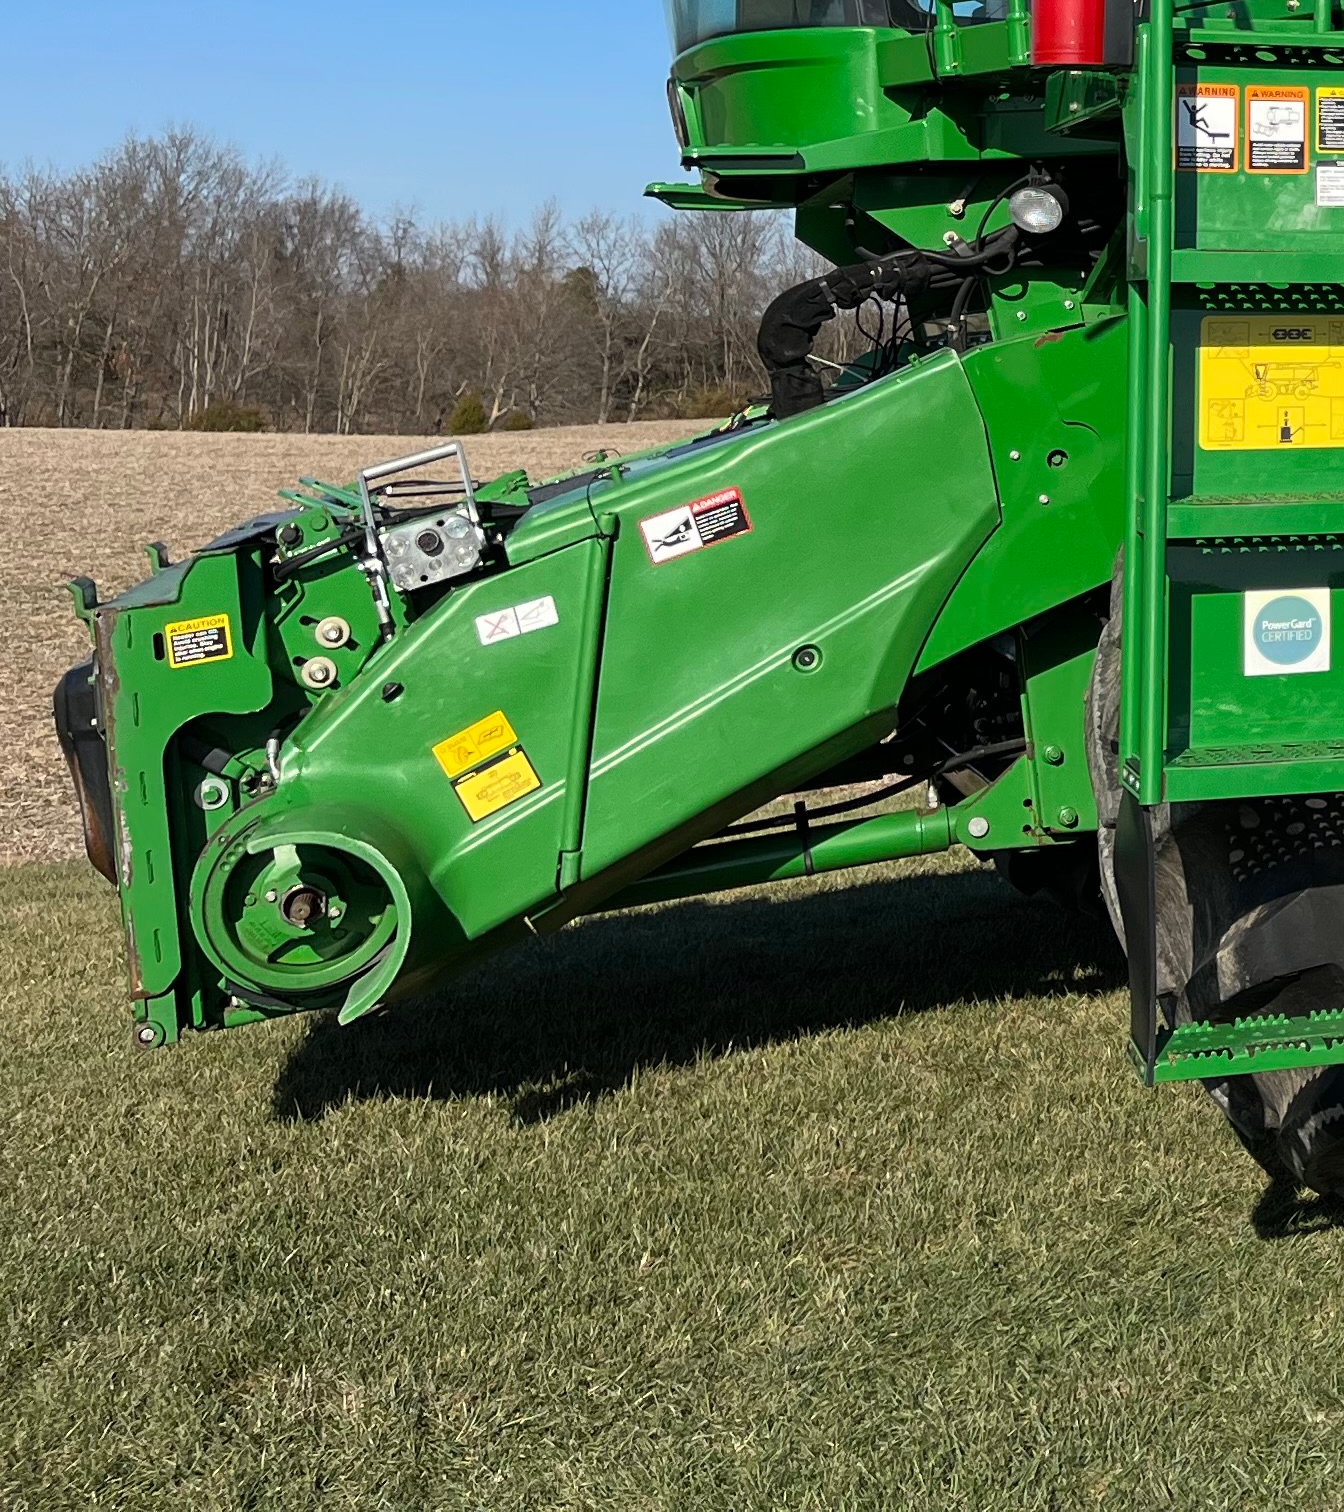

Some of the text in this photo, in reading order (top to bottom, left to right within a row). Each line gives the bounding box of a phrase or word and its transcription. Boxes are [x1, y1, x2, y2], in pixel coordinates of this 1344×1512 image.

[1189, 87, 1236, 97] WARNING
[1261, 90, 1304, 99] WARNING
[700, 489, 737, 507] DANGER
[177, 617, 225, 632] CAUTION
[1262, 629, 1313, 642] CERTIFIED
